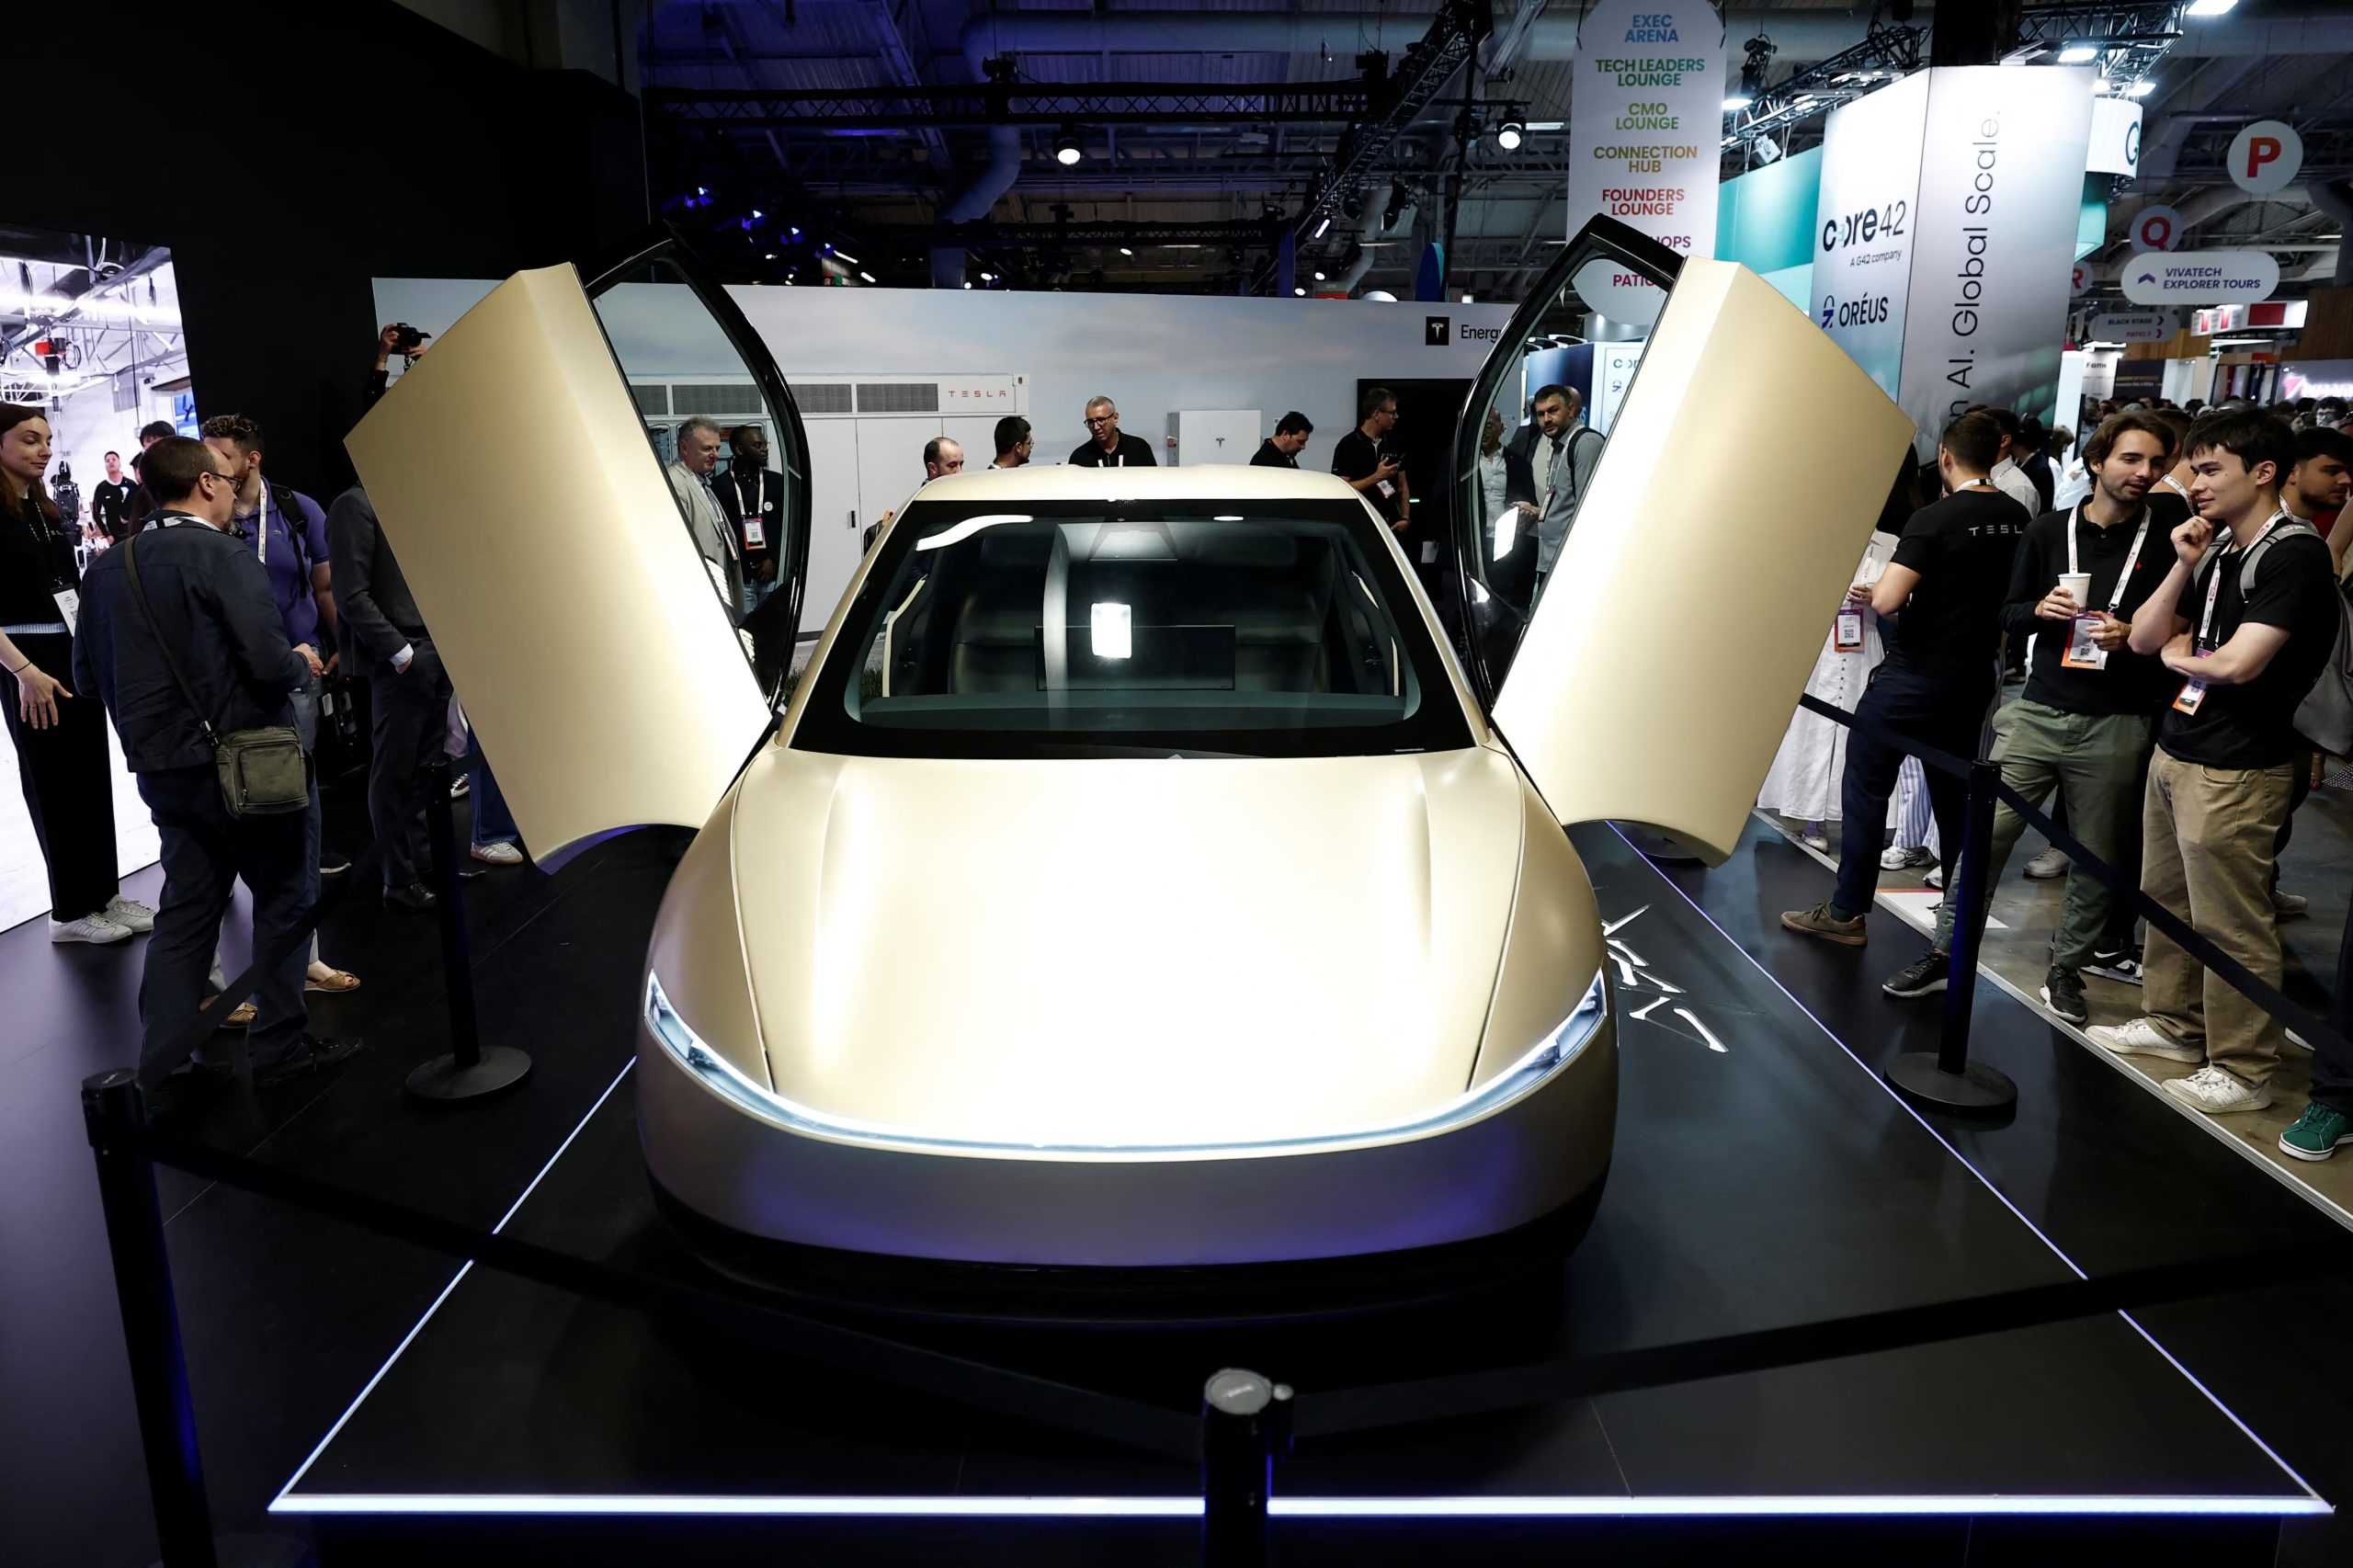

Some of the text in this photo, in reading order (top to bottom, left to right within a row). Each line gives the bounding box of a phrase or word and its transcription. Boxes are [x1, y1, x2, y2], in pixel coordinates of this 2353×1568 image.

[1631, 14, 1673, 28] EXEC
[1624, 28, 1679, 43] ARENA
[1596, 58, 1705, 73] TECH LEADERS
[1618, 73, 1681, 87] LOUNGE
[1629, 102, 1667, 116] CMO
[1616, 117, 1679, 131] LOUNGE
[1594, 145, 1698, 160] CONNECTION
[2246, 136, 2282, 178] P
[1628, 160, 1662, 174] HUB
[1965, 110, 2001, 215] Scale.
[1602, 188, 1685, 202] FOUNDERS
[1611, 202, 1674, 216] LOUNGE
[2141, 216, 2172, 251] Q
[1849, 250, 1903, 267] A G42 company
[2165, 267, 2222, 277] VIVATECH
[1951, 228, 1989, 337] Global
[2163, 278, 2261, 290] EXPLORER TOURS
[1839, 291, 1889, 327] ORÉUS
[1461, 324, 1501, 344] Energ
[1967, 524, 2023, 537] TESL
